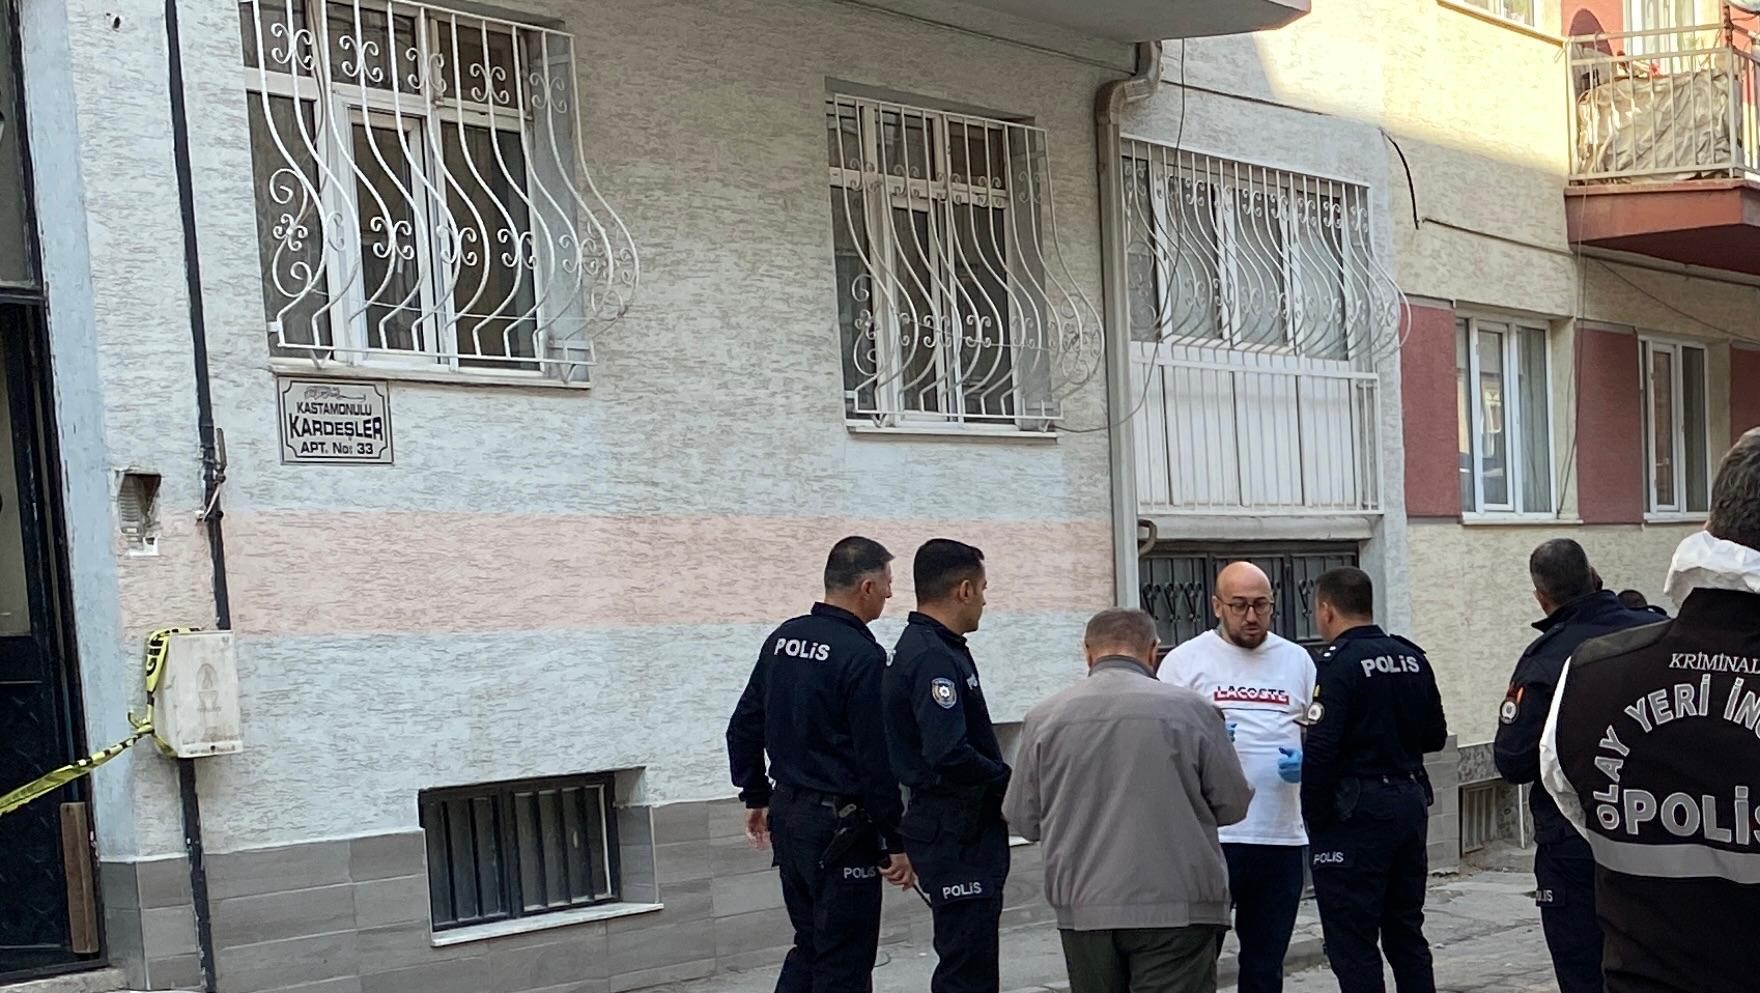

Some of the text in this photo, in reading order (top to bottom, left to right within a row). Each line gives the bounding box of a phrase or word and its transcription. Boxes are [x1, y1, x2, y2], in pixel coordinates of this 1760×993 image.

[296, 402, 372, 416] KASTAMONULU
[289, 413, 383, 441] KARDEŞLER
[300, 441, 329, 454] APT.
[356, 443, 374, 455] 33
[1217, 685, 1288, 702] LACOSTE
[1593, 725, 1630, 830] OLAY
[1624, 673, 1711, 733] YERİ
